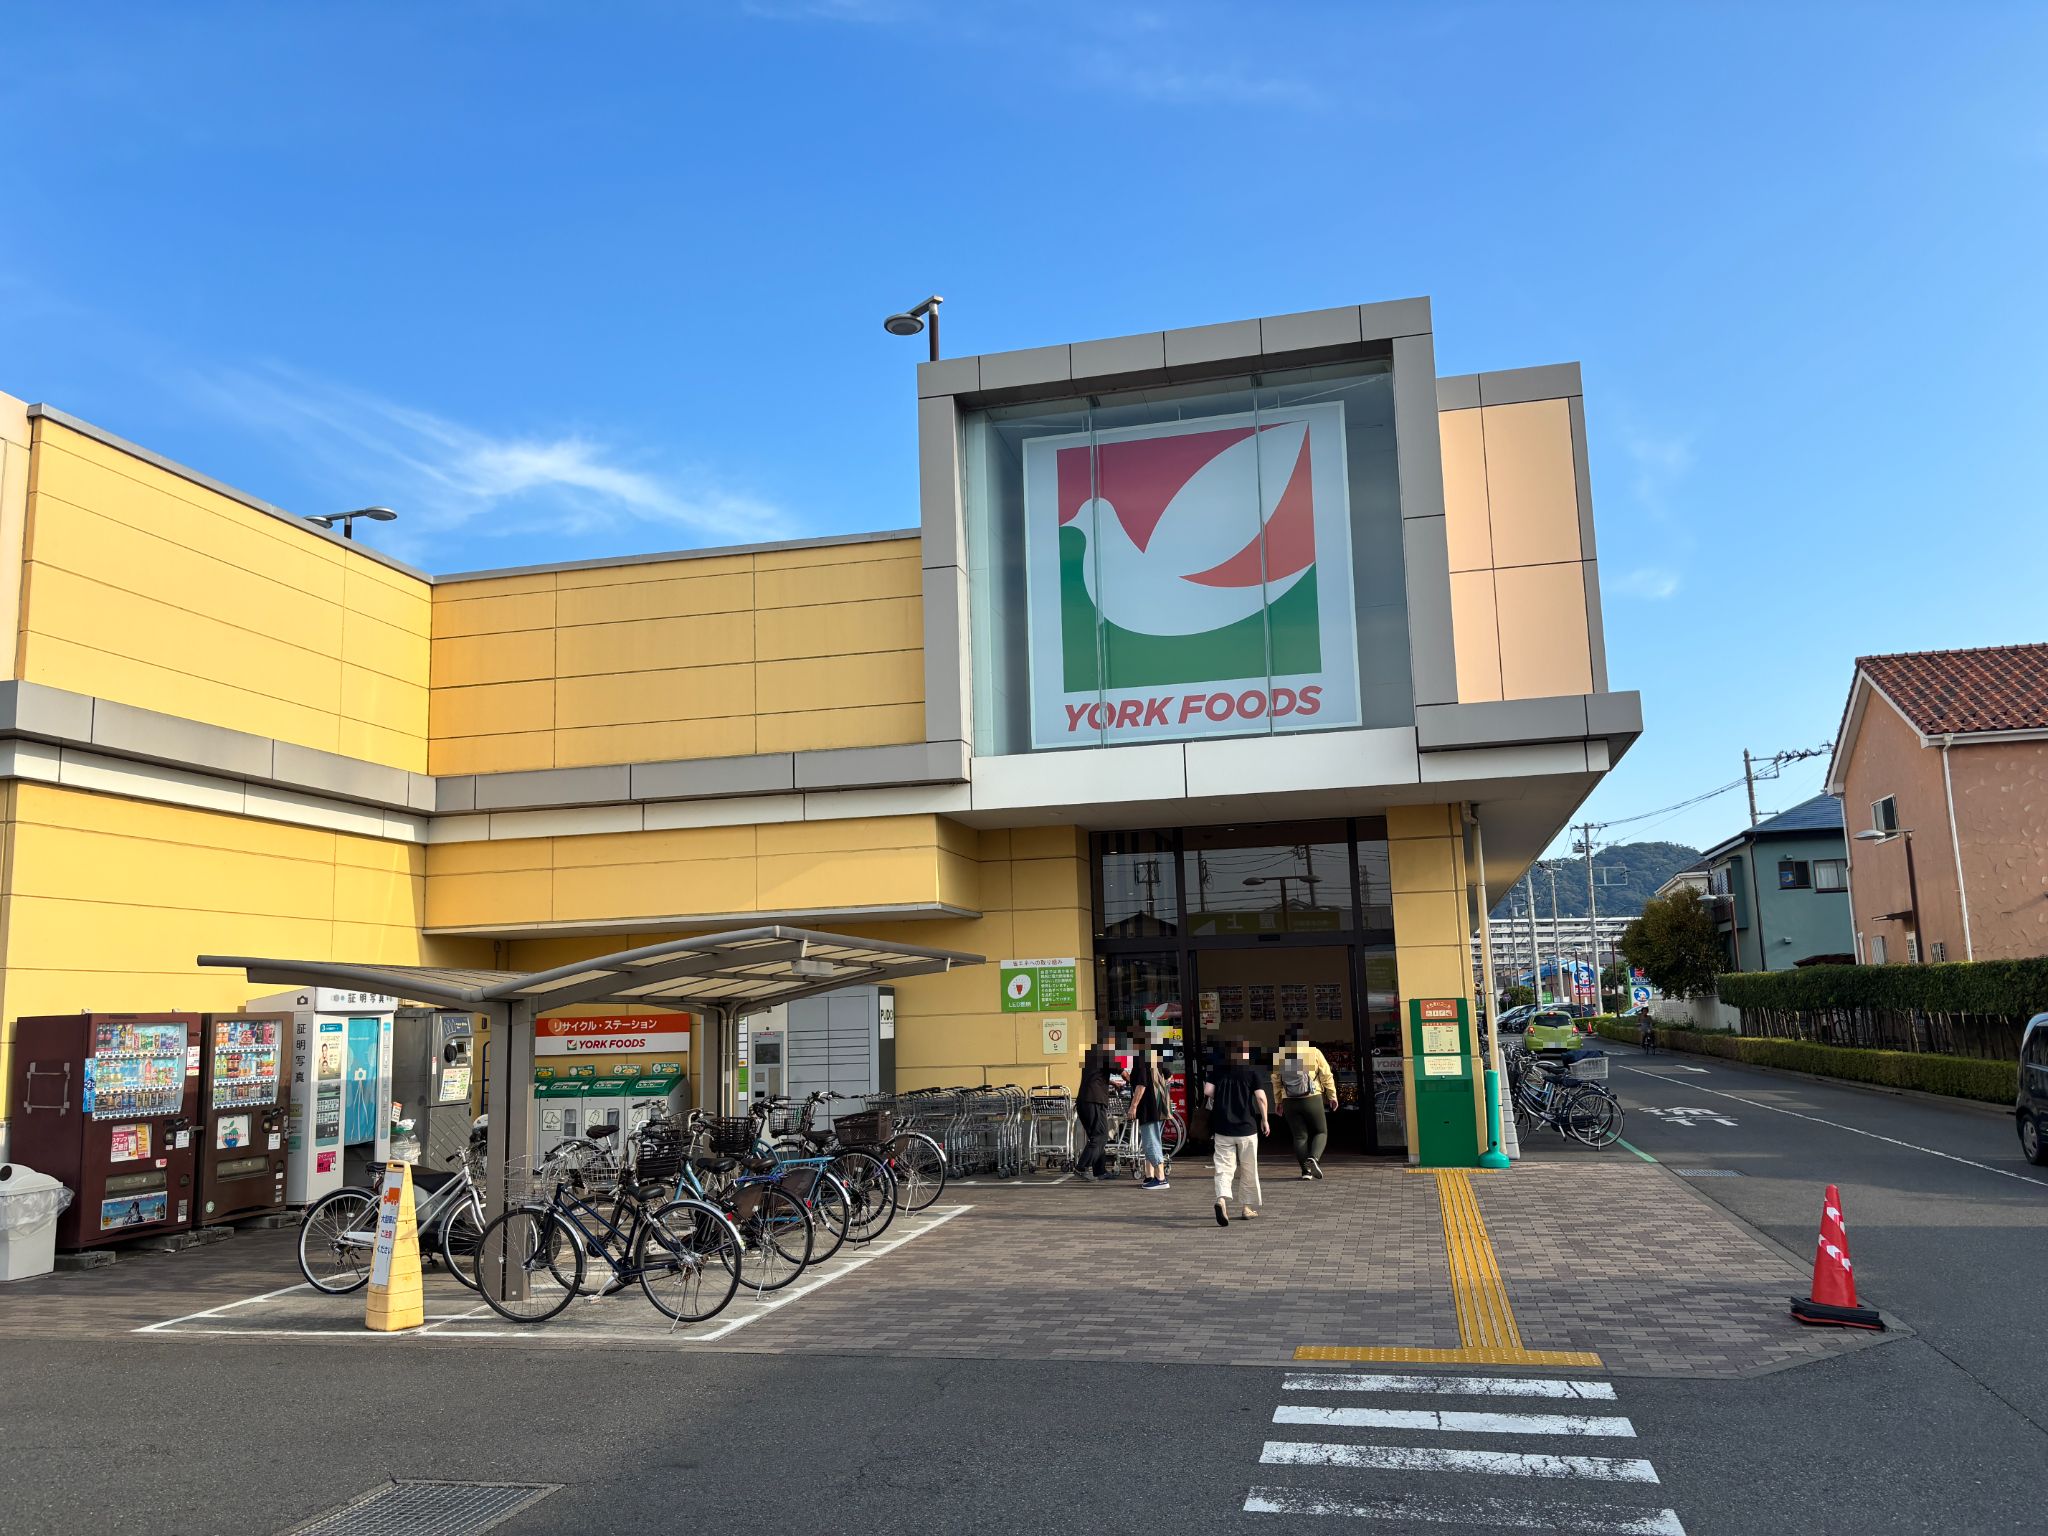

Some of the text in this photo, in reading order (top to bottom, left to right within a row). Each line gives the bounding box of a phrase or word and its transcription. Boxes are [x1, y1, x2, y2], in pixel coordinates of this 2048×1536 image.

[1065, 685, 1323, 732] YORK FOODS
[347, 993, 385, 1003] 証明写真
[554, 1019, 657, 1032] リサイクル・ステーション
[579, 1038, 646, 1049] YORK FOODS
[296, 1023, 306, 1083] 証明写真
